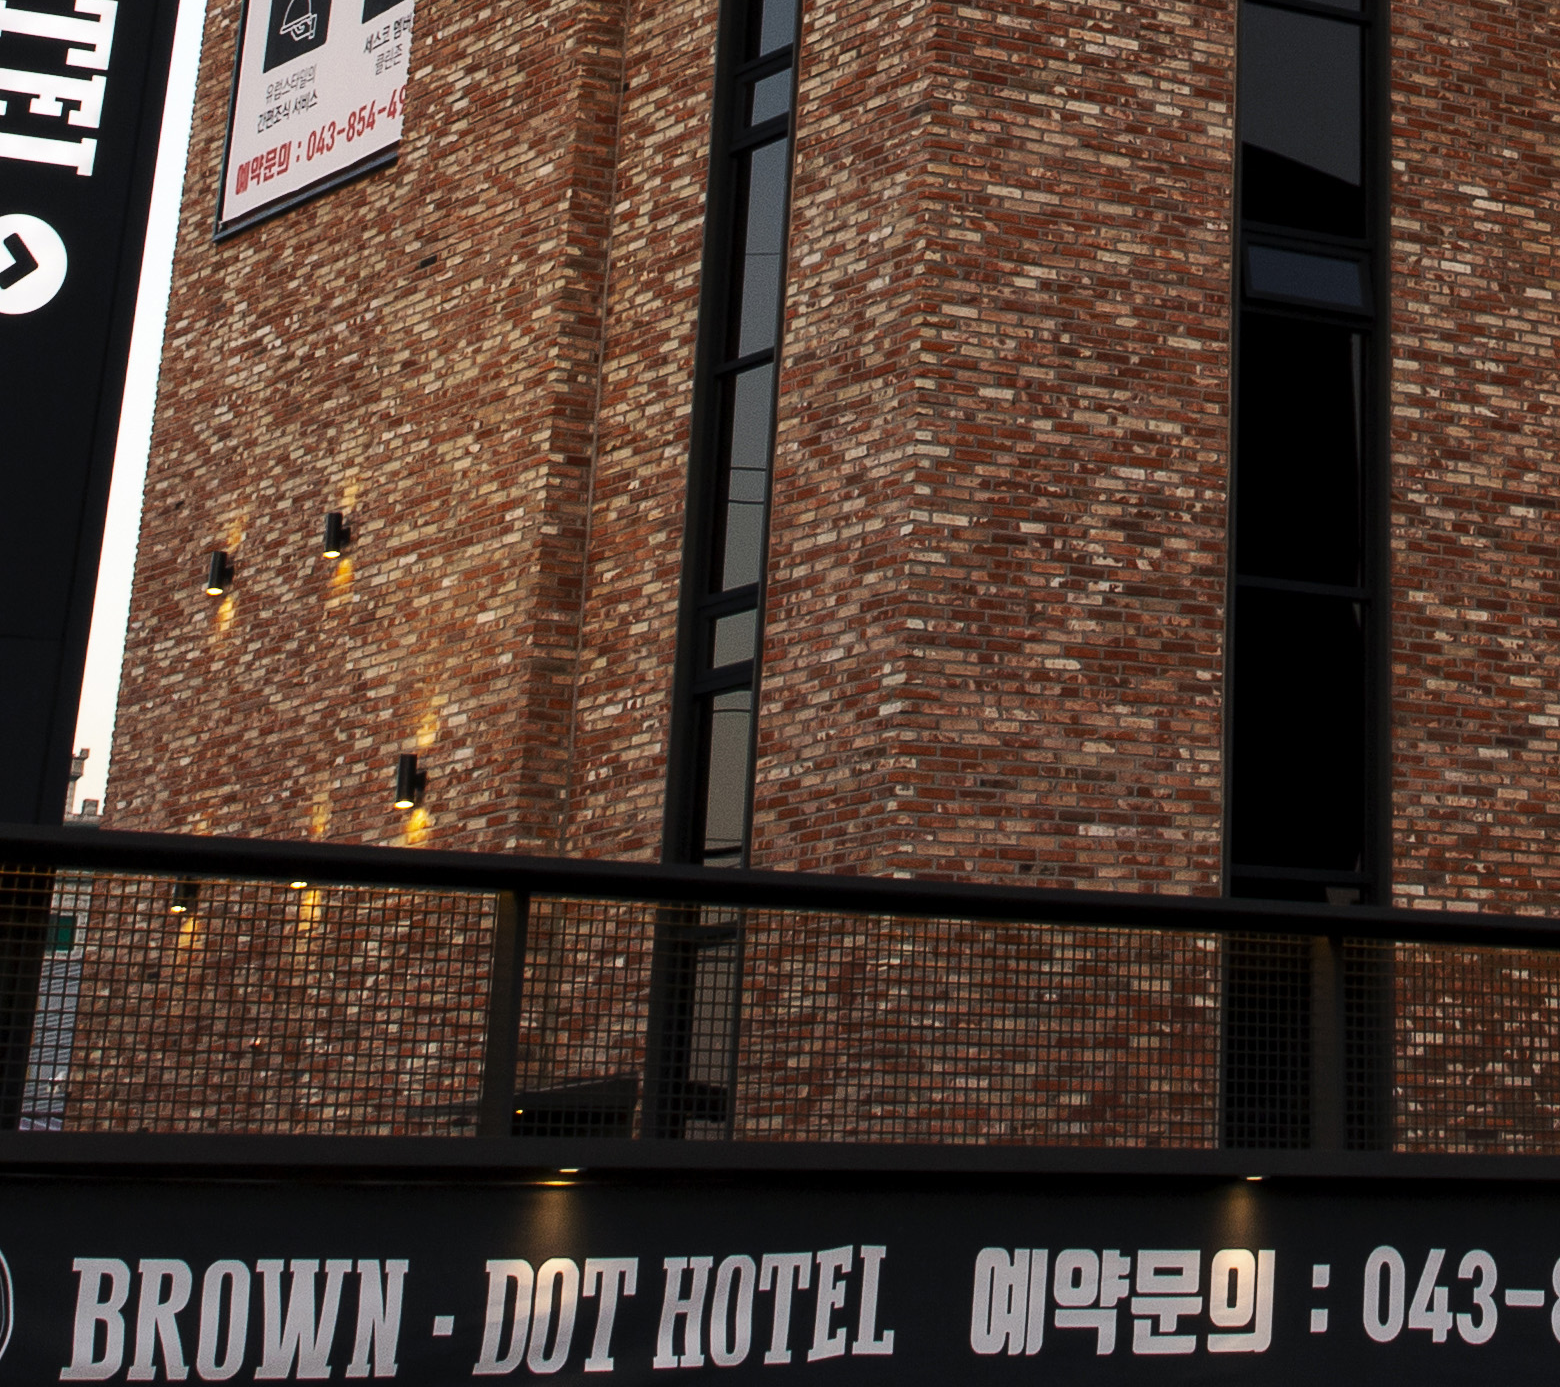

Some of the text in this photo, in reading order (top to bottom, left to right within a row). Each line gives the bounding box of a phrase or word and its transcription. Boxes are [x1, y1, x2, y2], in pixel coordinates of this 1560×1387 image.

[235, 140, 292, 196] 예약문의
[59, 1257, 410, 1381] BROWN
[472, 1257, 639, 1375] DOT
[652, 1244, 895, 1369] HOTEL
[970, 1247, 1276, 1356] 예약문의
